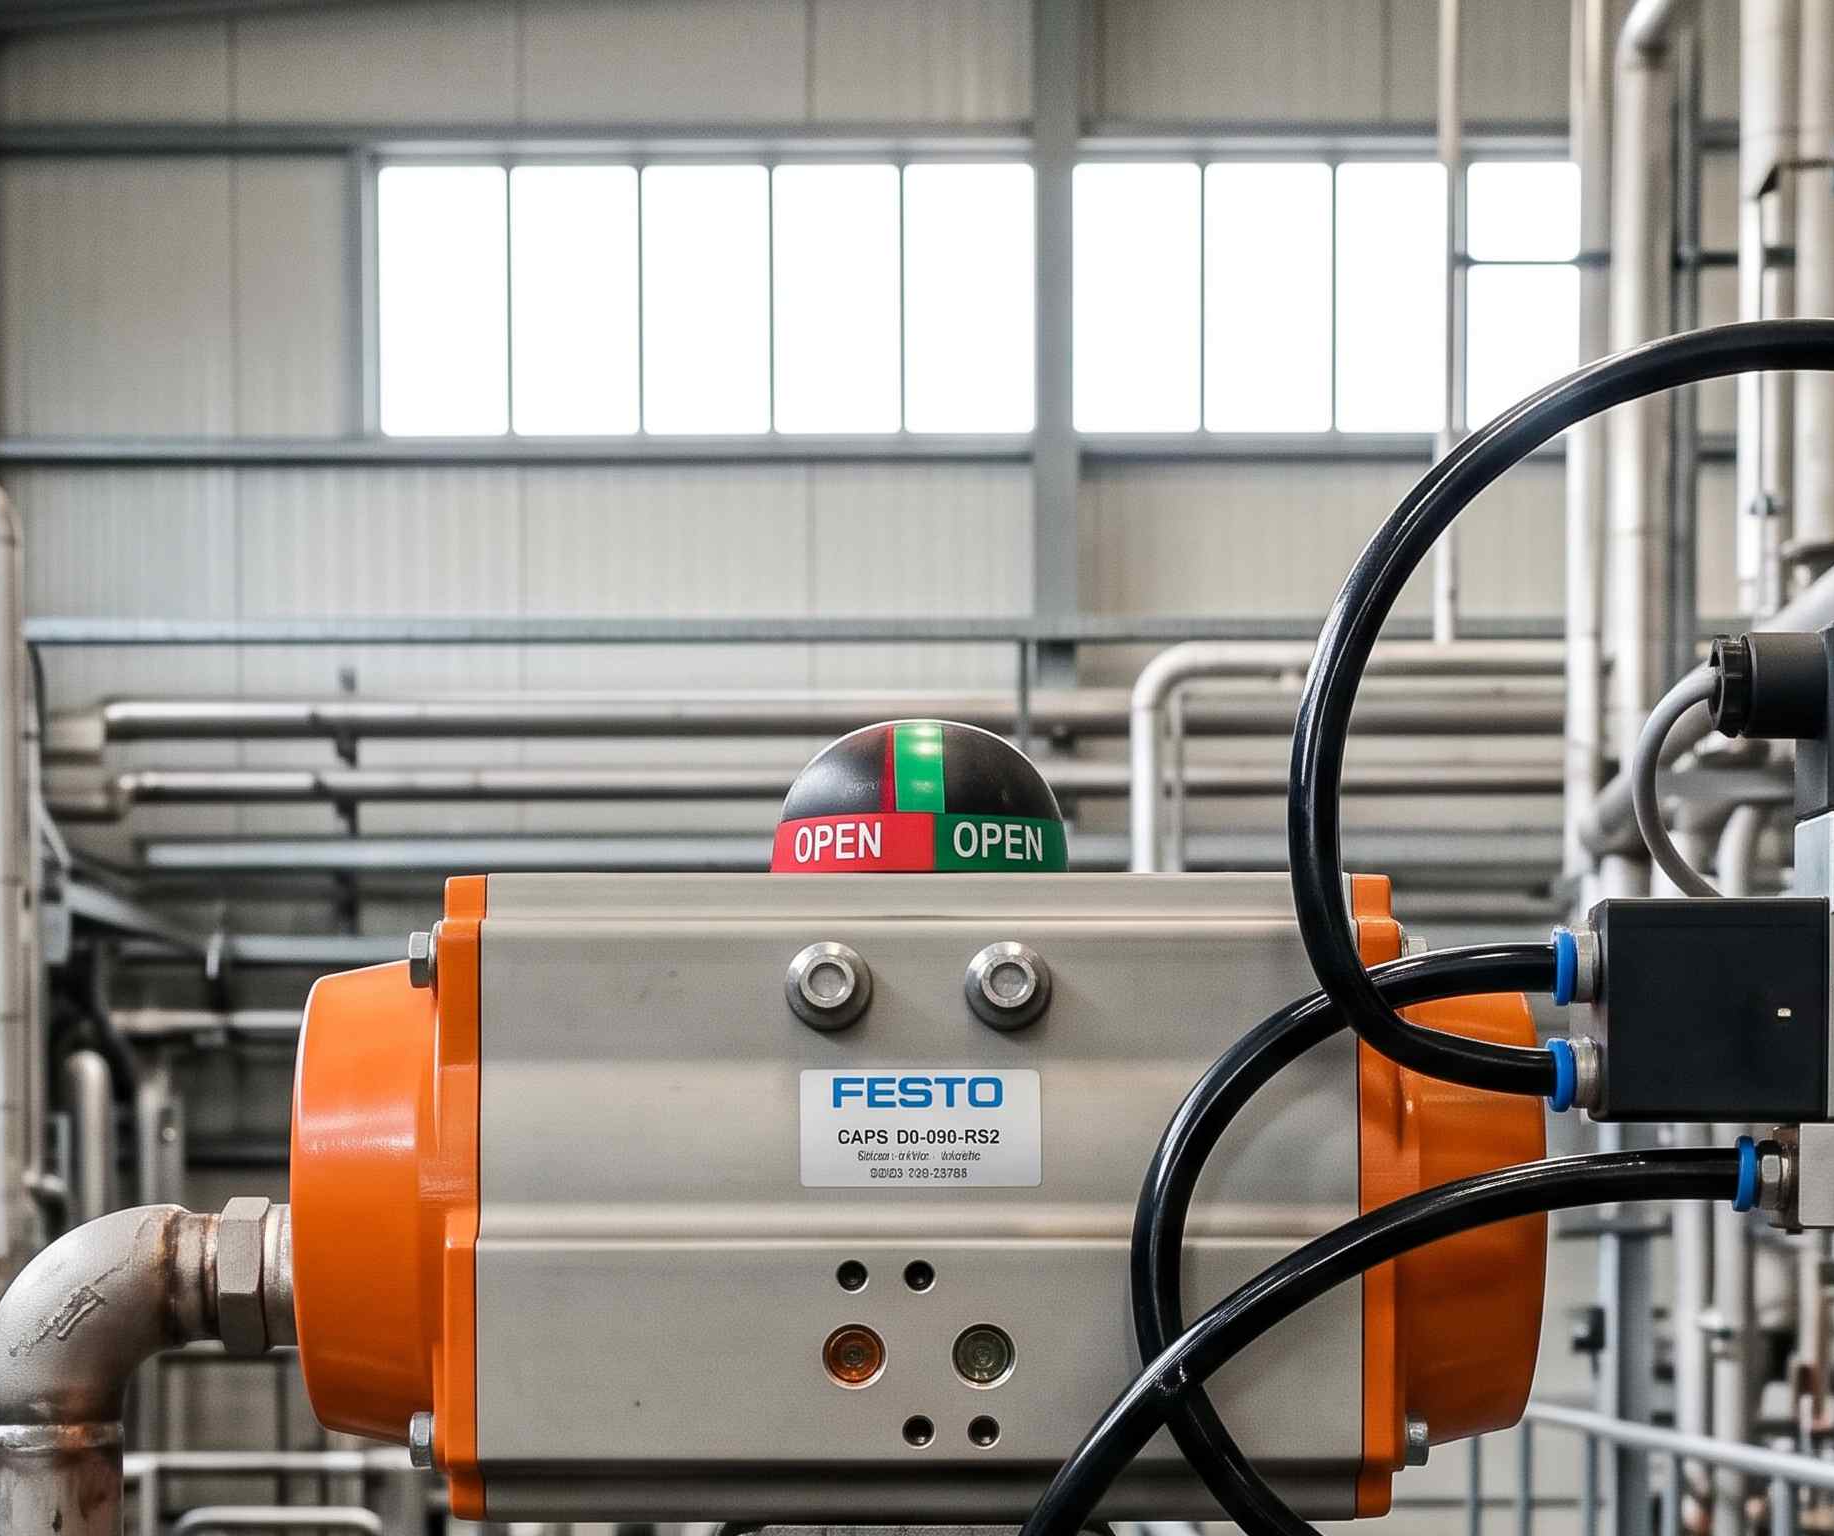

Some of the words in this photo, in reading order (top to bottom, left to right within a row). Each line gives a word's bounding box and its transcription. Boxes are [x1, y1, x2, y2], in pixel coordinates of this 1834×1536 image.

[794, 822, 882, 863] OPEN
[953, 821, 1044, 862] OPEN
[832, 1077, 1004, 1108] FESTO
[837, 1129, 889, 1145] CAPS
